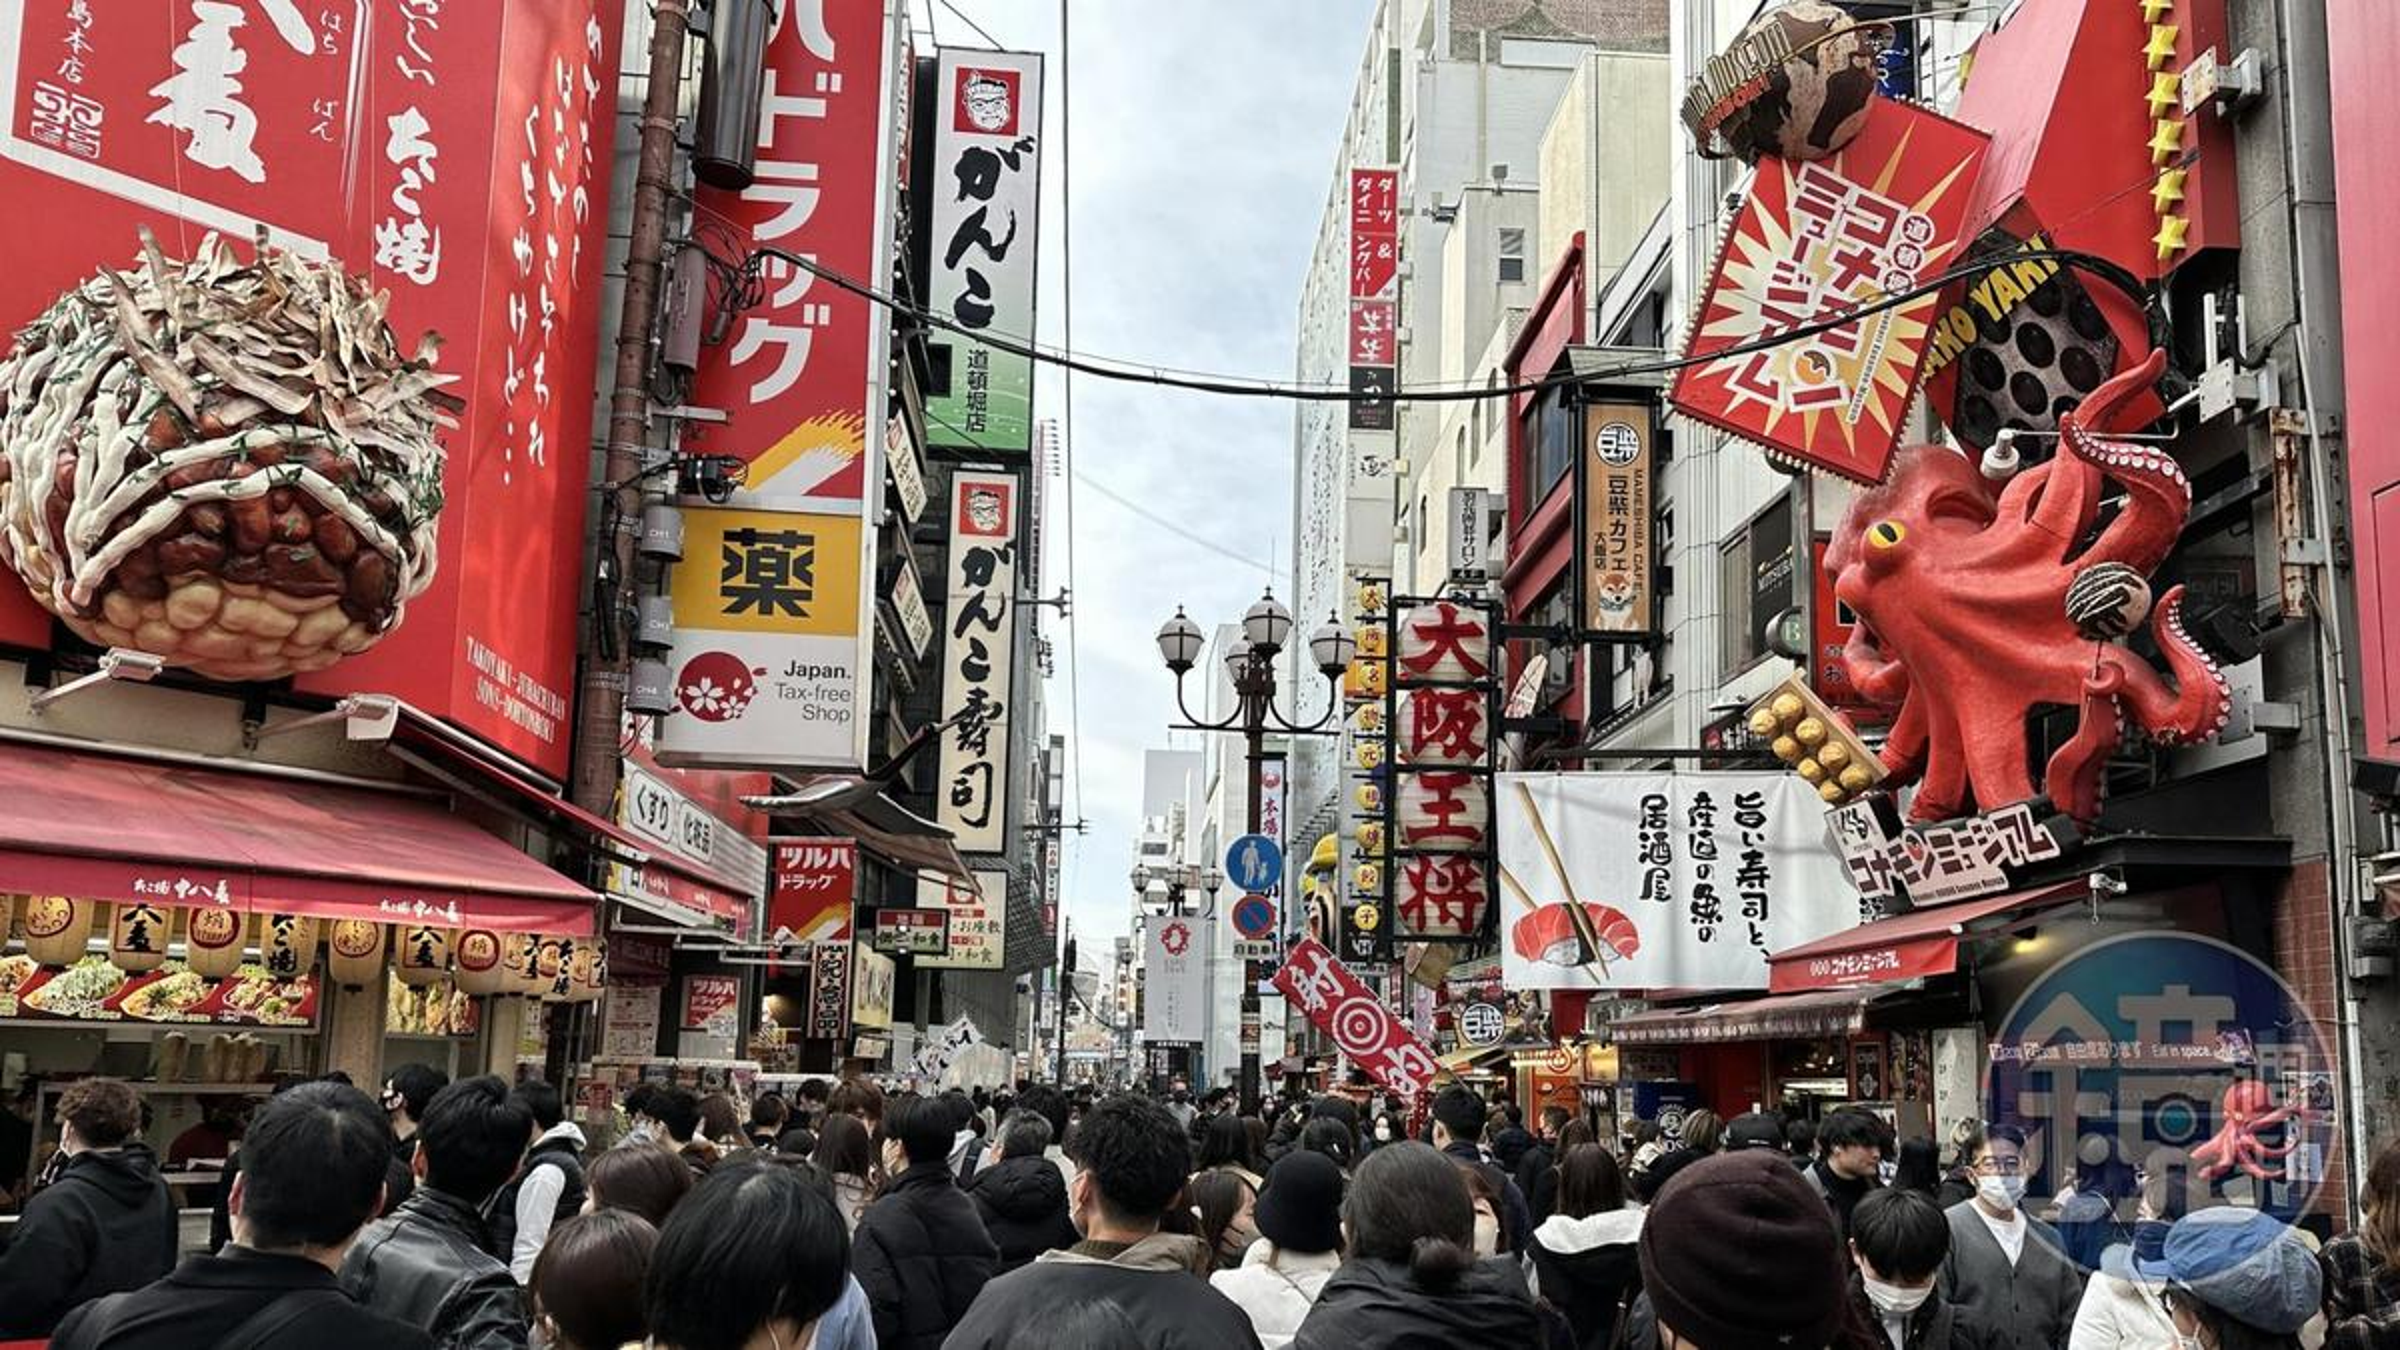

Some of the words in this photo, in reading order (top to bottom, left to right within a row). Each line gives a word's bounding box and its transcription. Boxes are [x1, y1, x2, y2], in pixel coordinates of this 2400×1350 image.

[944, 135, 1036, 329] がんこ
[1607, 474, 1630, 572] 豆柴カフェ
[721, 528, 816, 619] 薬
[775, 682, 851, 702] Tax-free
[783, 659, 852, 681] Japan.
[802, 704, 850, 725] Shop
[1399, 602, 1493, 935] 大阪王将
[636, 783, 669, 830] くすり
[779, 846, 852, 871] ツルハ
[1638, 793, 1672, 902] 居酒屋
[778, 873, 838, 892] ドラッグ
